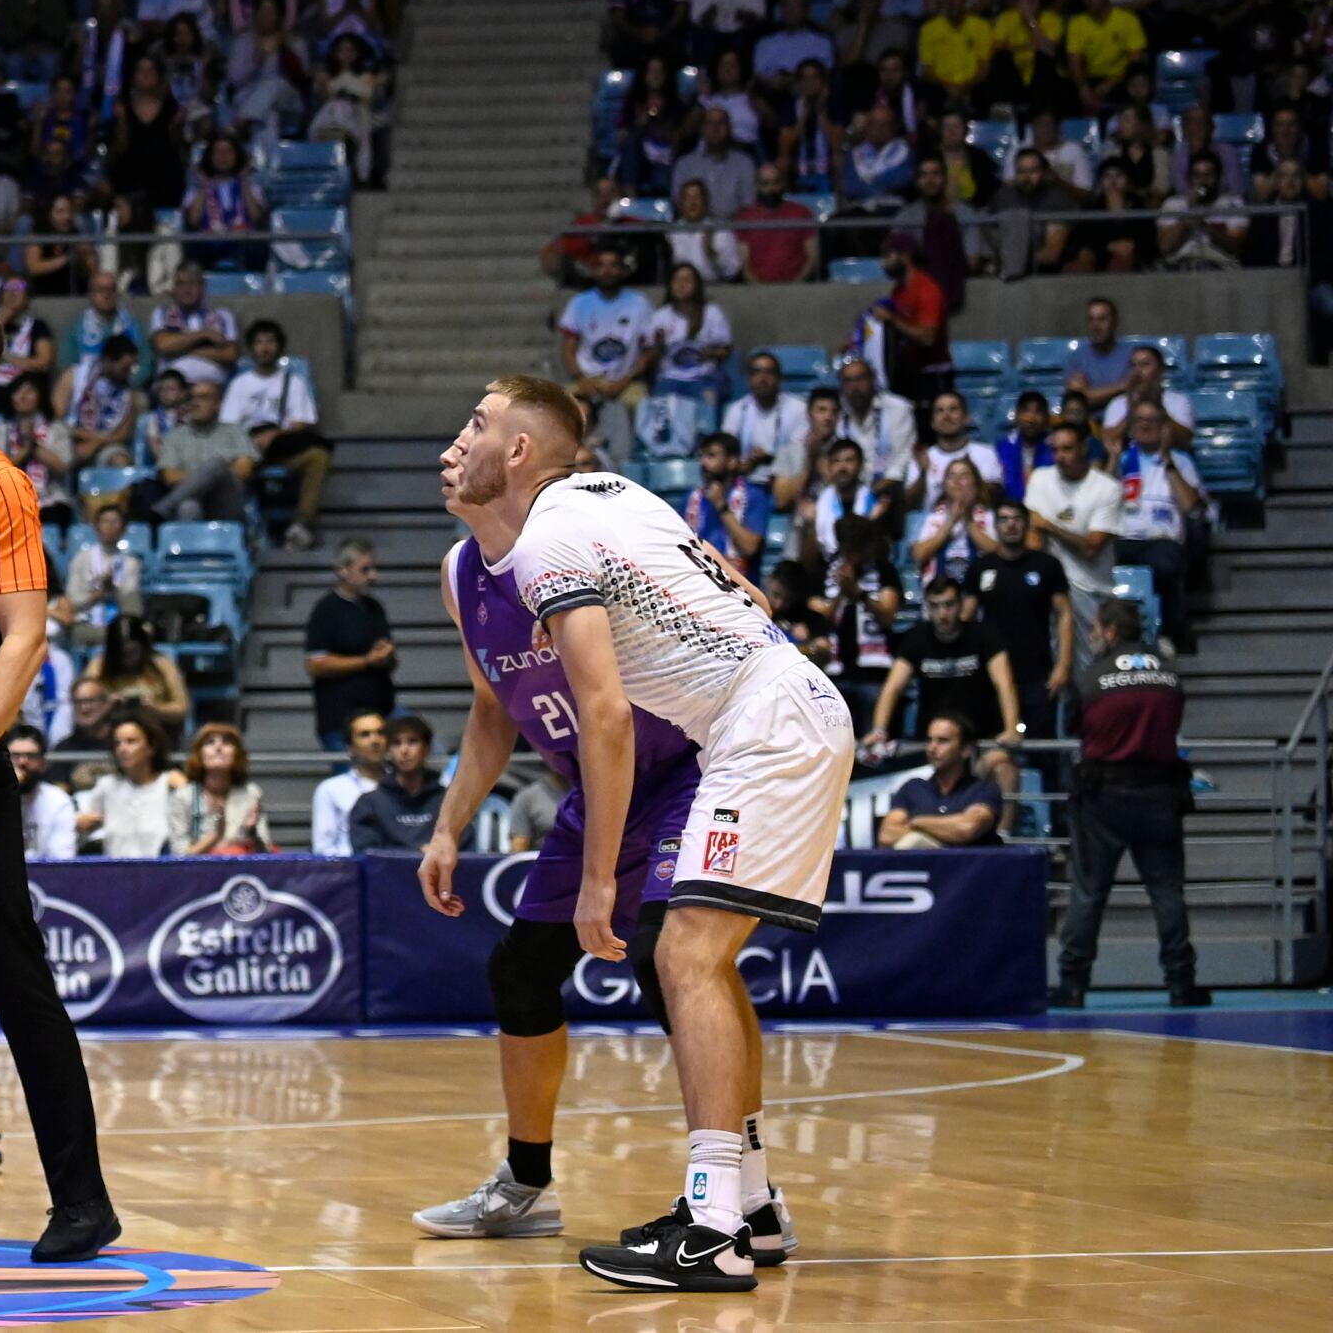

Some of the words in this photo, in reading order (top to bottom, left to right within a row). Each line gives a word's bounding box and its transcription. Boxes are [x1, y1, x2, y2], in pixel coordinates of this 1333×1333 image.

[532, 691, 579, 741] 21
[714, 813, 734, 822] acb
[176, 918, 318, 958] Estrella
[185, 955, 313, 996] Galicia
[573, 946, 841, 1007] GCIA
